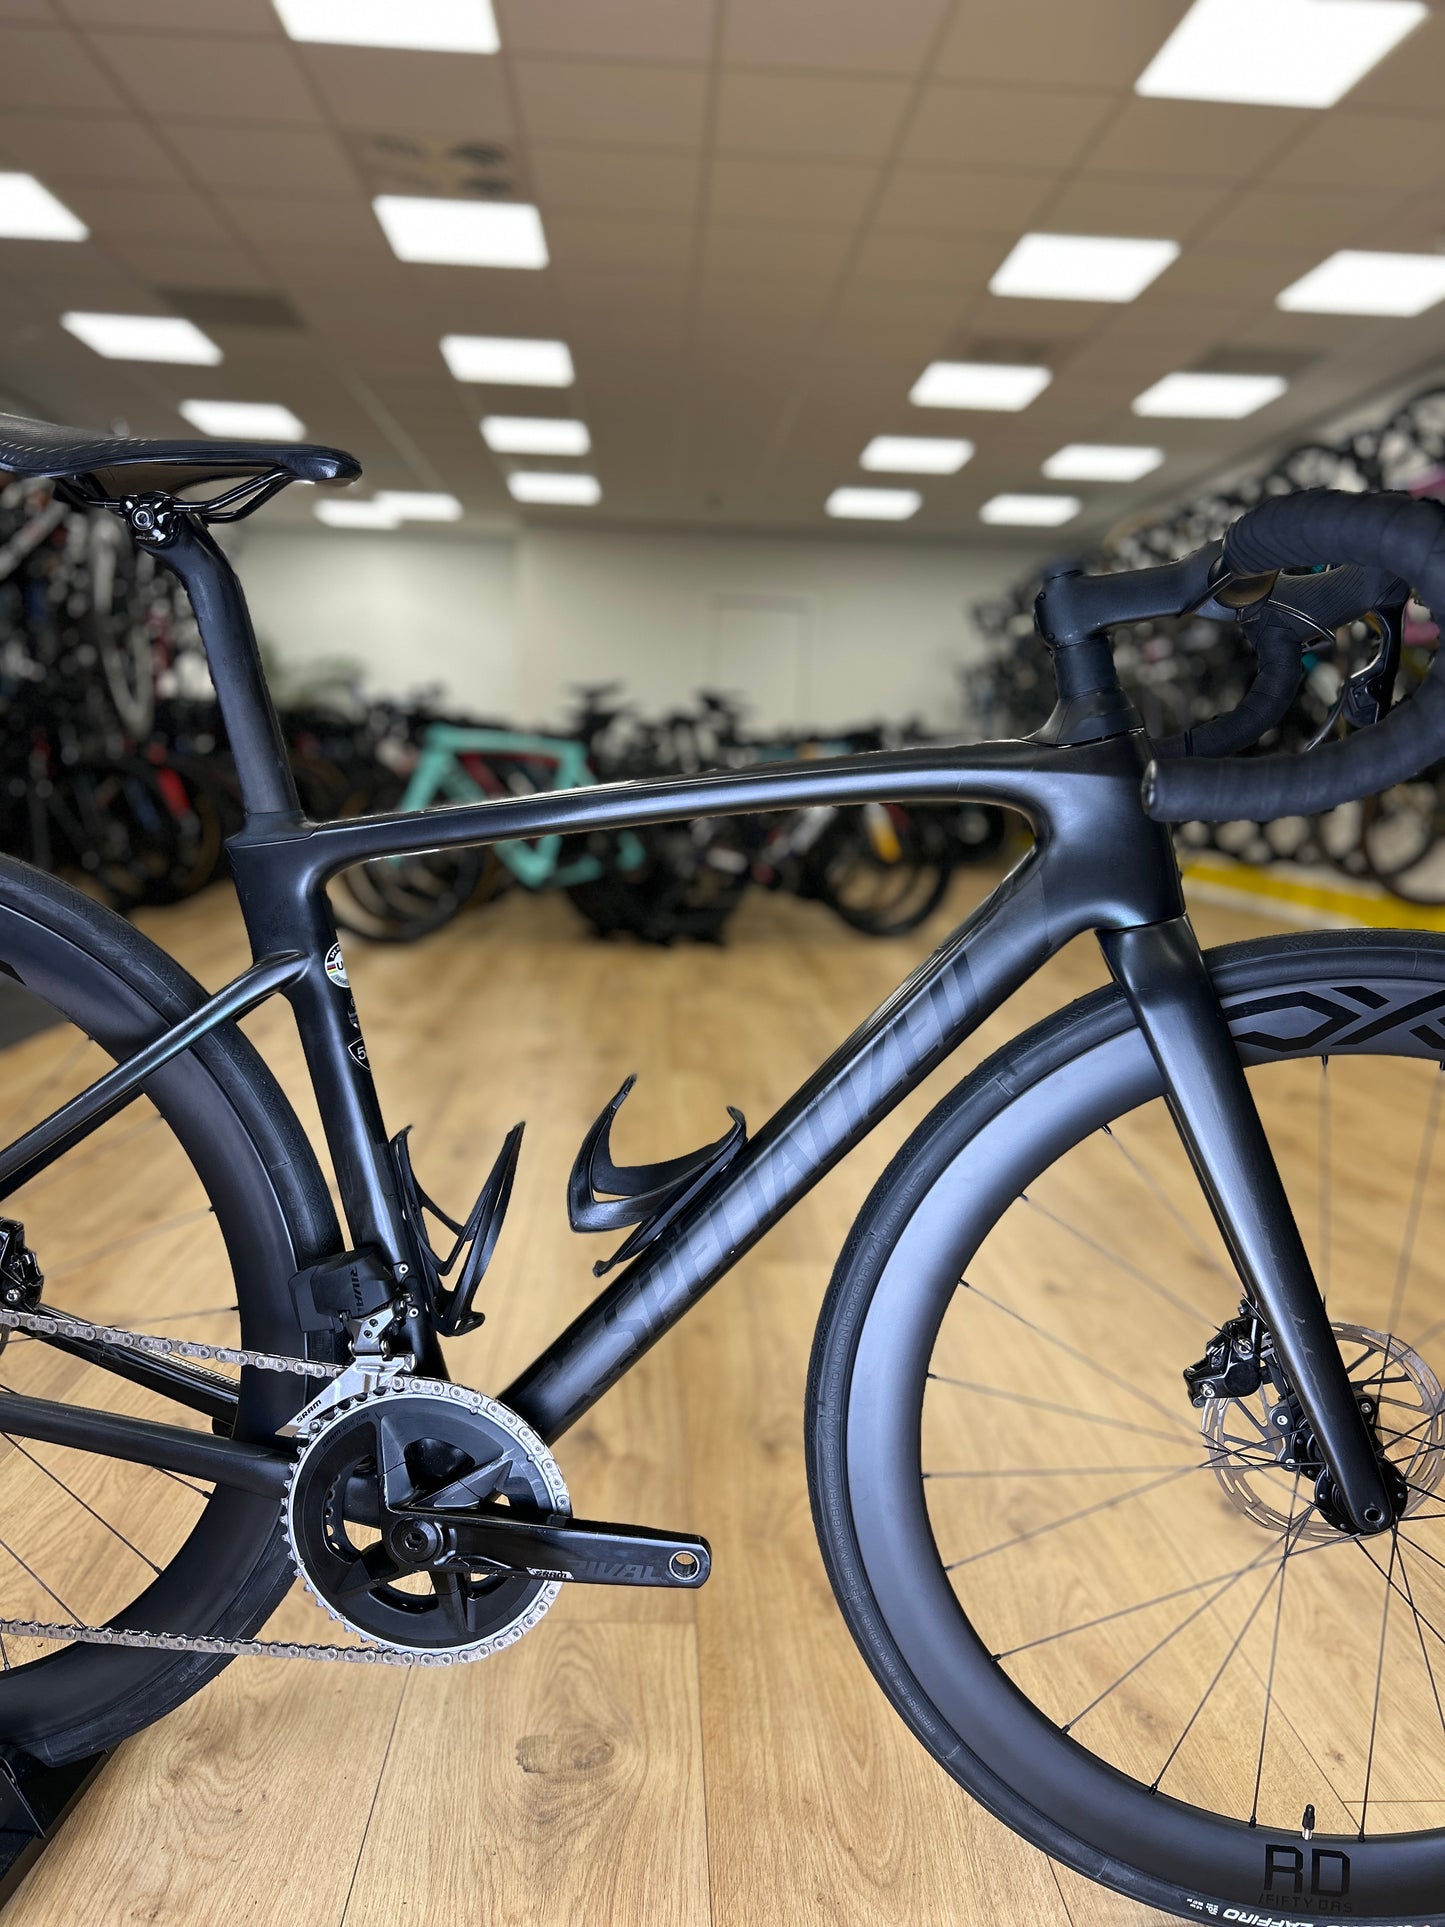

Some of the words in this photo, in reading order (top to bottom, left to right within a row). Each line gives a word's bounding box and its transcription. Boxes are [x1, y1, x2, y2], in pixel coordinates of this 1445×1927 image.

[861, 1255, 875, 1279] RIM
[350, 1266, 365, 1316] RIVAL
[841, 1277, 867, 1328] HOOKED
[837, 1329, 849, 1346] ON
[831, 1348, 844, 1380] ONLY
[296, 1399, 322, 1423] SRAM
[828, 1381, 840, 1427] MOUNT
[1263, 1843, 1351, 1897] RD
